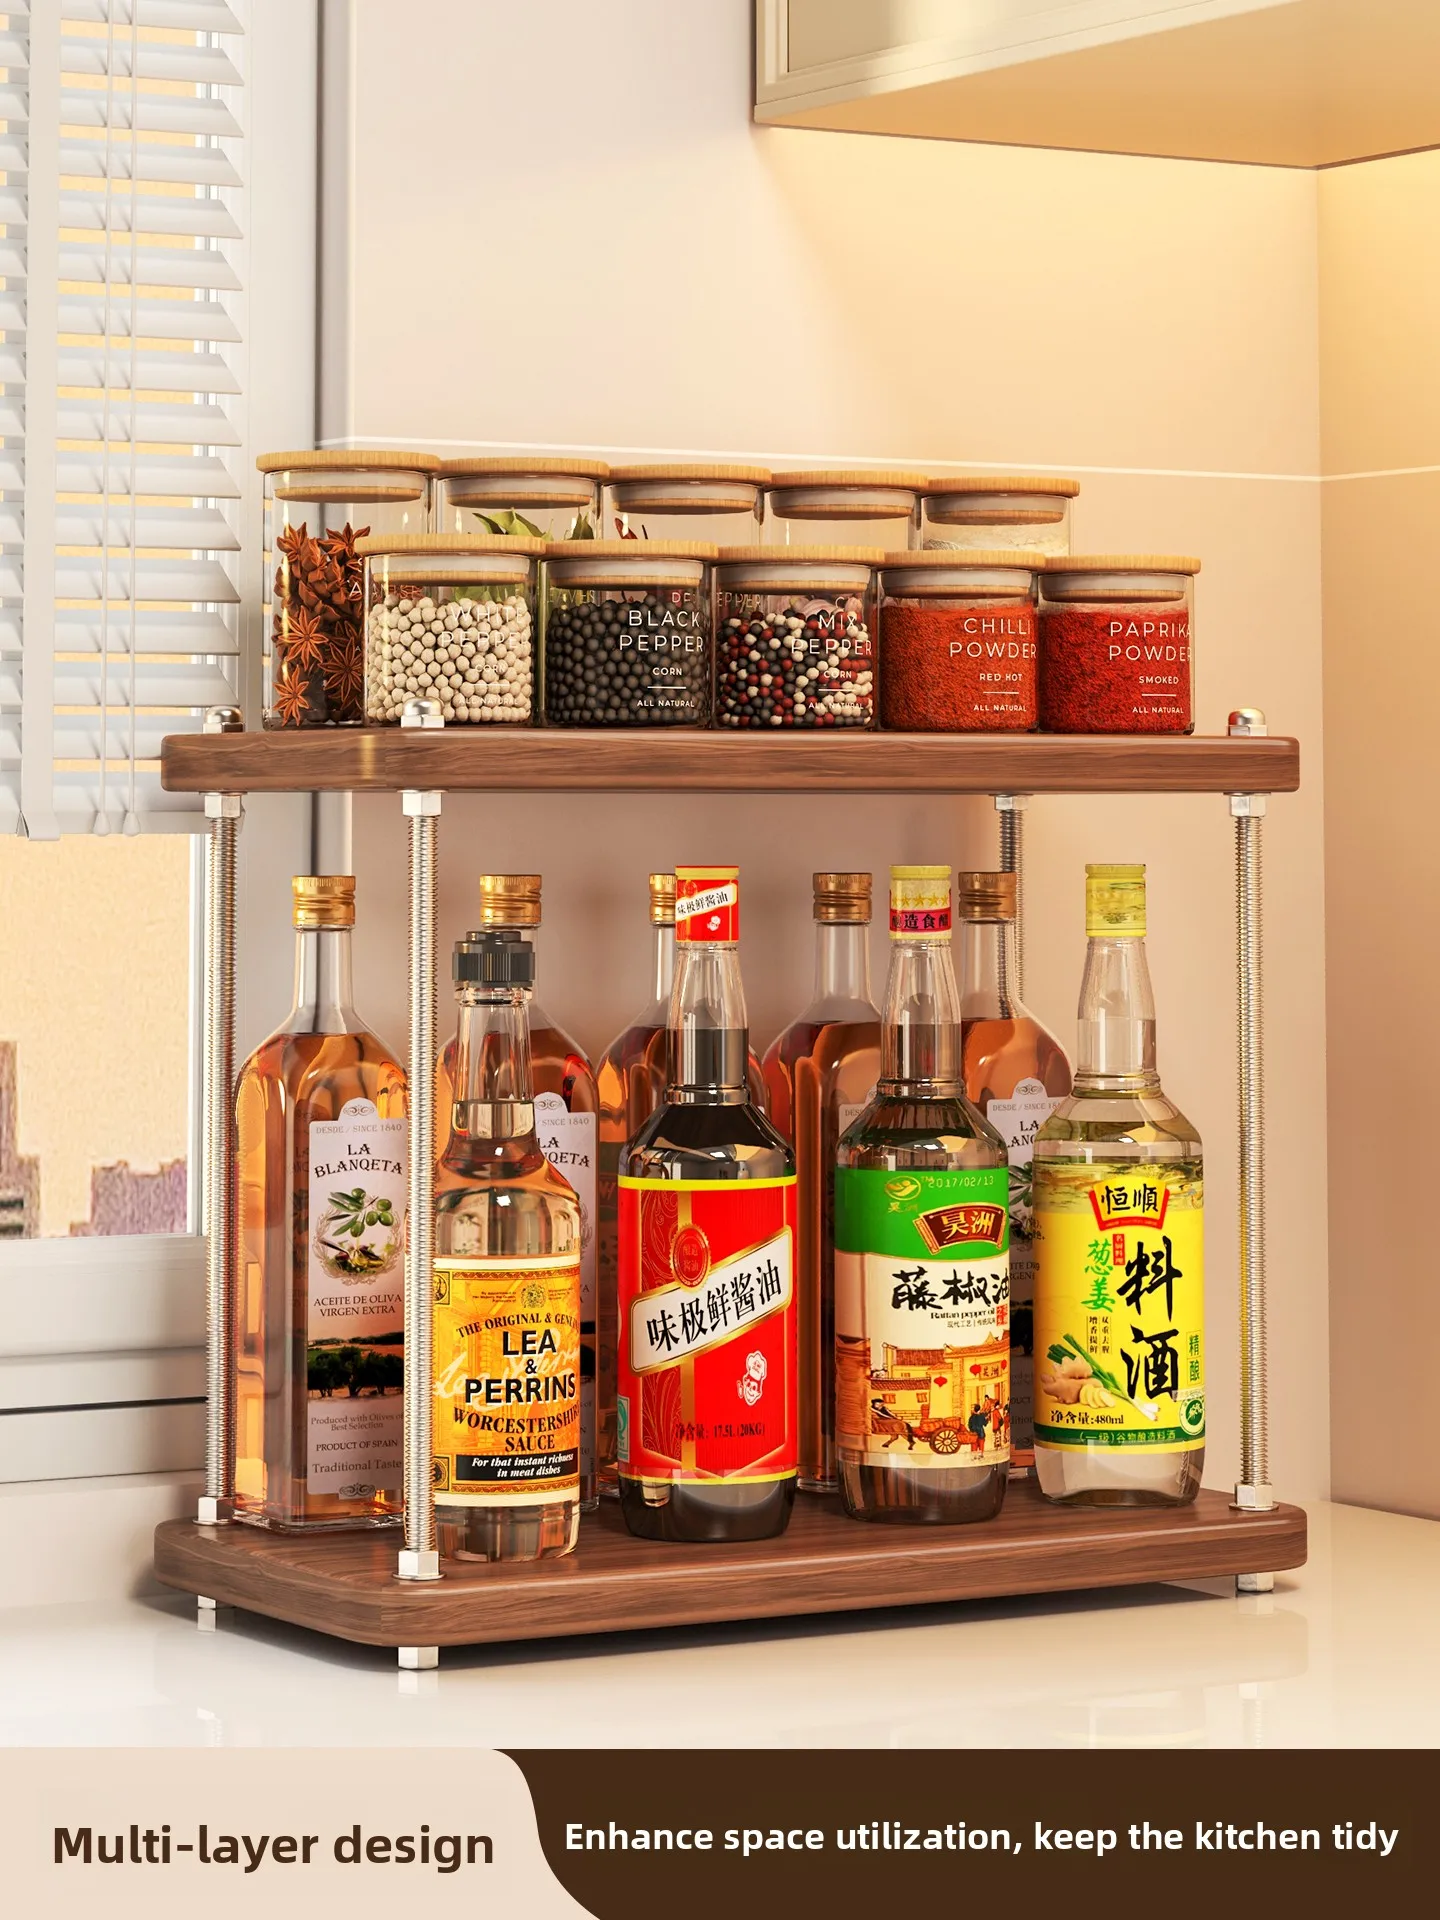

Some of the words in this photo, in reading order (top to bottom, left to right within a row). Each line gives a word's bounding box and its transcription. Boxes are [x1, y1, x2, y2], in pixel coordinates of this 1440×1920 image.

[451, 606, 525, 624] WHITE
[628, 610, 701, 628] BLACK
[818, 614, 857, 631] MIX
[963, 617, 1031, 634] CHILLI
[619, 634, 704, 652] PEPPER
[791, 638, 872, 656] PEPPER
[949, 641, 1037, 659] POWDER
[1109, 645, 1192, 662] POWDER
[652, 667, 683, 677] CORN
[823, 670, 852, 679] CORN
[979, 673, 1002, 682] RED
[1005, 673, 1023, 682] HOT
[1138, 675, 1180, 685] SMOKED
[637, 699, 656, 707] ALL
[658, 699, 695, 708] NATURAL
[808, 702, 826, 710] ALL
[828, 702, 864, 710] NATURAL
[993, 704, 1027, 712] NATURAL
[1132, 706, 1149, 714] ALL
[1151, 706, 1184, 714] NATURAL
[993, 1103, 1016, 1112] DESDE
[1024, 1102, 1046, 1111] SINCE
[542, 1118, 566, 1126] SINCE
[569, 1117, 590, 1125] 1840
[1020, 1119, 1040, 1132] LA
[316, 1125, 344, 1134] DESDE
[353, 1124, 378, 1133] SINCE
[381, 1123, 402, 1132] 1840
[347, 1143, 371, 1156] LA
[314, 1158, 403, 1179] BLANQETA
[928, 1175, 994, 1188] 2017/02/13
[1081, 1238, 1116, 1313] 葱姜
[891, 1265, 1010, 1312] 藤椒油
[314, 1296, 351, 1307] ACEITE
[353, 1295, 367, 1304] DE
[369, 1294, 403, 1304] OLIVA
[646, 1258, 782, 1352] 味极鲜酱油
[320, 1306, 360, 1317] VIRGEN
[362, 1305, 396, 1315] EXTRA
[456, 1321, 483, 1338] THE
[484, 1312, 542, 1330] ORIGINAL
[544, 1312, 552, 1323] &
[1116, 1235, 1183, 1402] 料酒
[503, 1328, 557, 1356] LEA
[525, 1358, 538, 1375] &
[465, 1372, 576, 1404] PERRINS
[311, 1415, 348, 1425] Produced
[349, 1413, 368, 1422] with
[369, 1412, 395, 1421] Olives
[331, 1423, 348, 1431] Best
[349, 1421, 384, 1430] Selection
[316, 1441, 358, 1452] PRODUCT
[359, 1440, 370, 1449] OF
[371, 1439, 398, 1449] SPAIN
[505, 1434, 556, 1453] SAUCE
[312, 1460, 372, 1473] Traditional
[374, 1458, 402, 1470] Taste
[472, 1457, 489, 1467] For
[491, 1457, 511, 1467] that
[514, 1456, 547, 1467] instant
[548, 1453, 574, 1464] richness
[497, 1468, 508, 1478] in
[510, 1467, 535, 1477] meat
[536, 1465, 561, 1476] dishes
